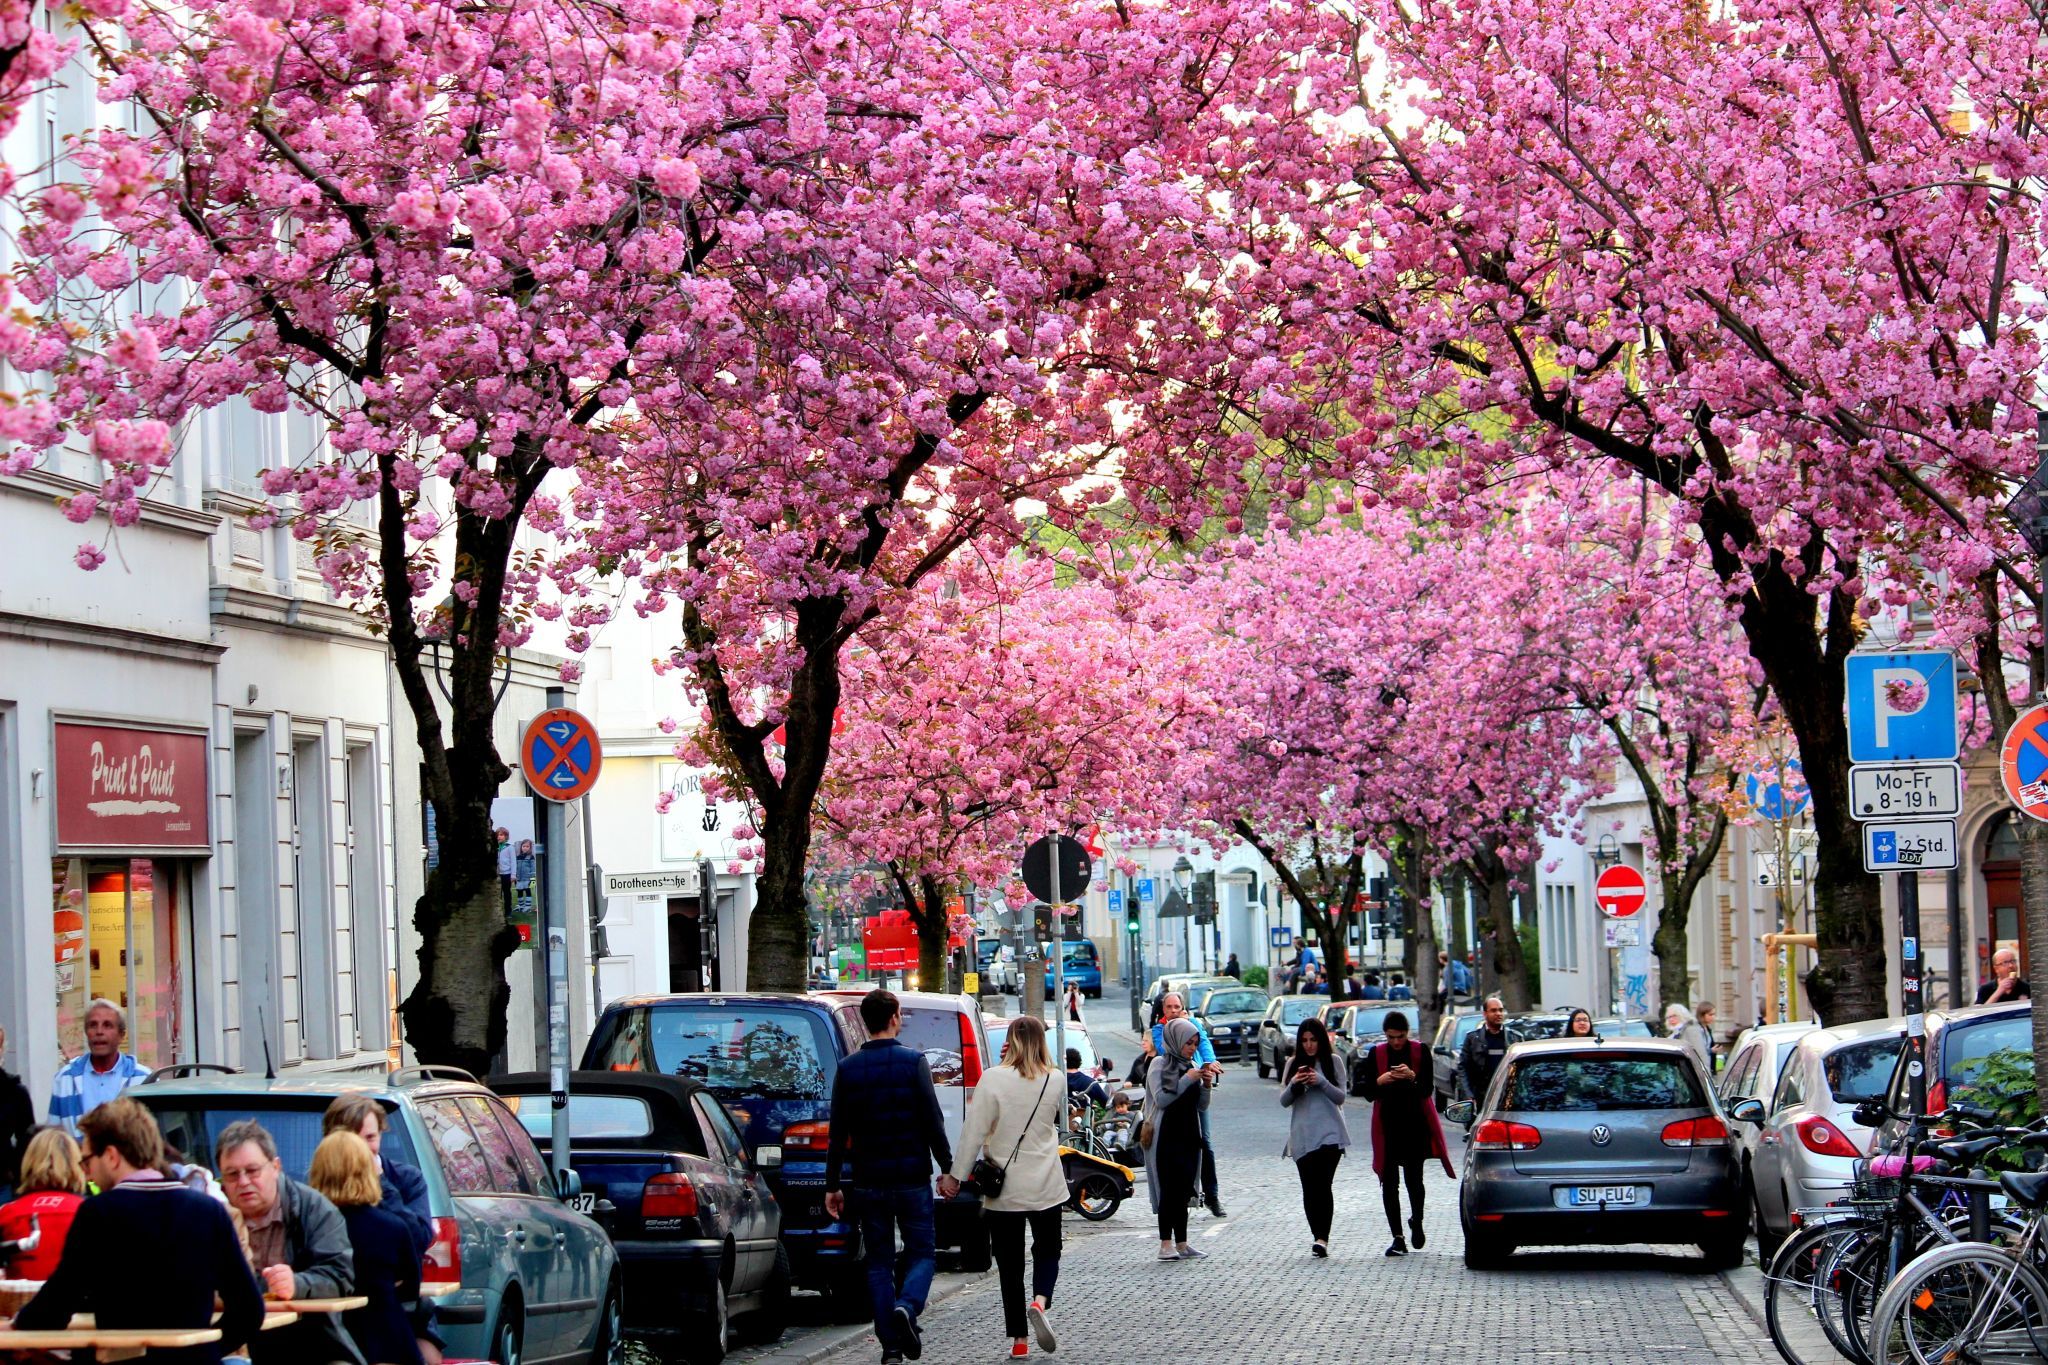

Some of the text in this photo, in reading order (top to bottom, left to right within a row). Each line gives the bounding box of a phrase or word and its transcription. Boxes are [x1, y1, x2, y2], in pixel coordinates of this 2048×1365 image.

[1873, 668, 1930, 748] P
[91, 741, 175, 798] Print & Paint
[1876, 772, 1932, 790] Mo-Fr
[1929, 791, 1937, 807] h
[1904, 838, 1948, 853] 2 Std.
[1579, 1188, 1596, 1202] SU
